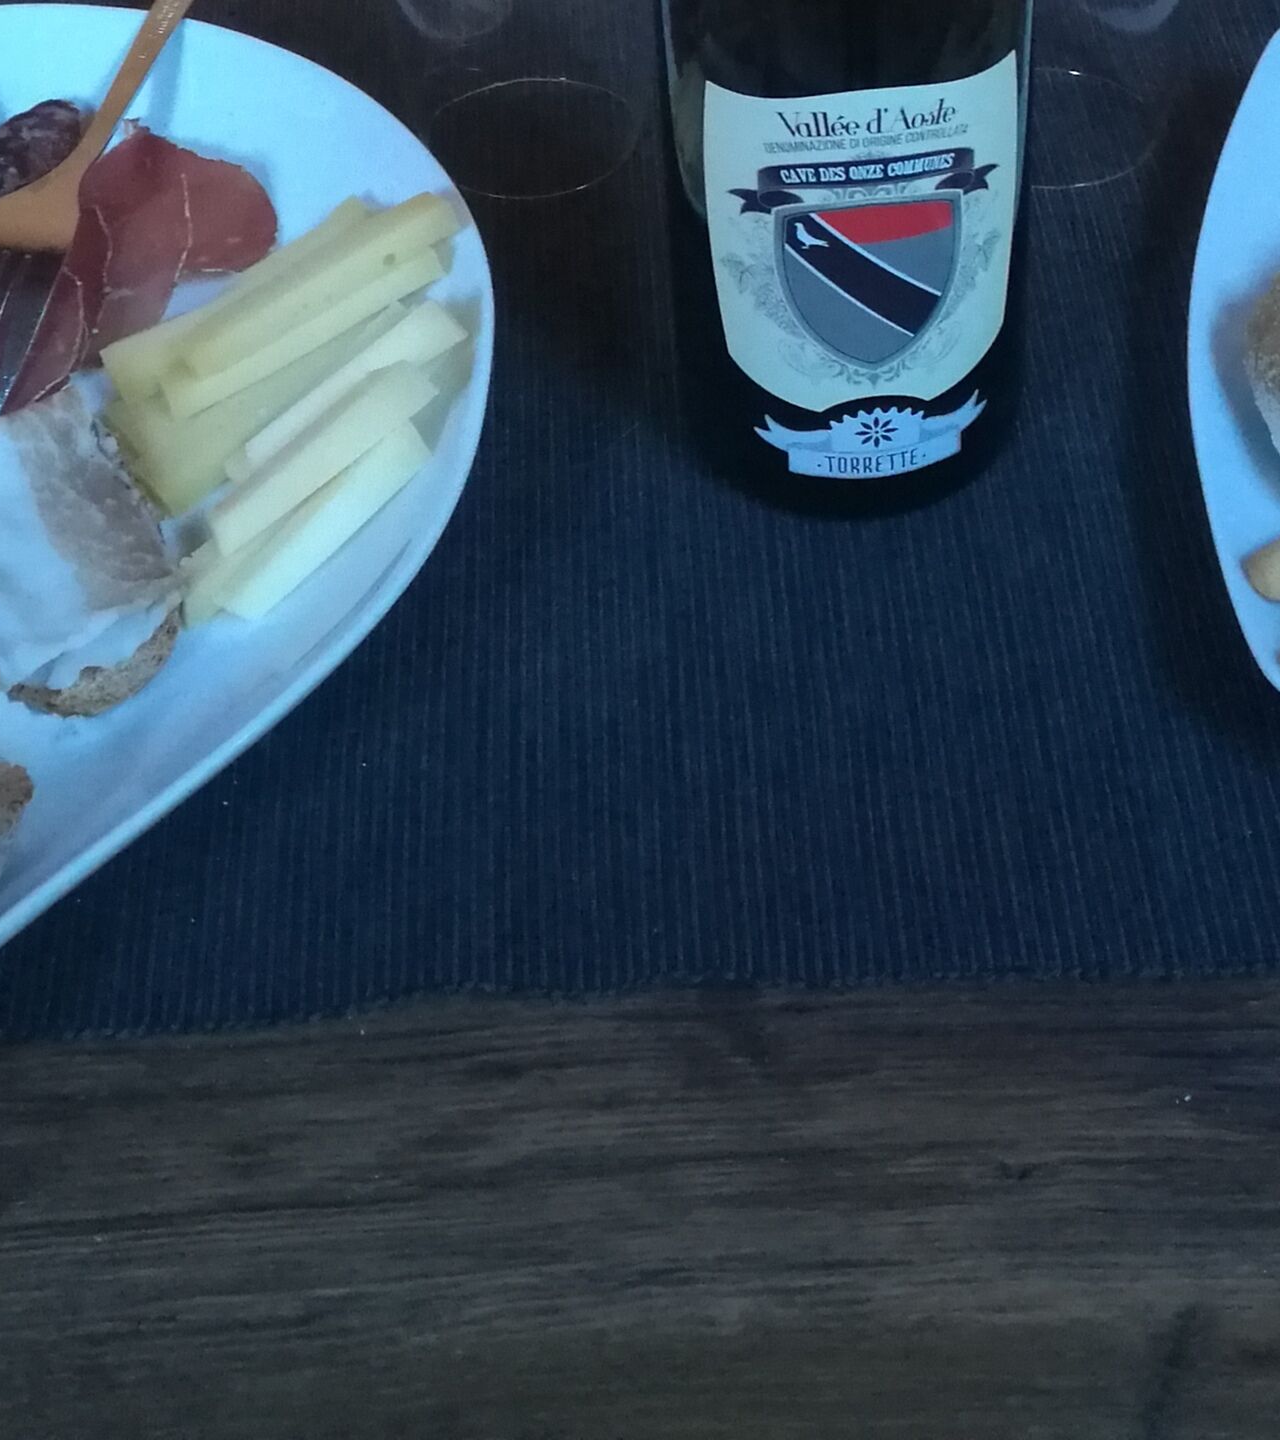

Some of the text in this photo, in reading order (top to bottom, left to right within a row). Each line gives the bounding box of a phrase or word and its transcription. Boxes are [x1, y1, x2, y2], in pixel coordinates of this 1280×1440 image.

[775, 110, 860, 138] Vallée
[849, 138, 860, 150] DI
[780, 153, 956, 184] CAVE DES ONZE COMMUNES
[824, 447, 919, 474] TORRETTE
